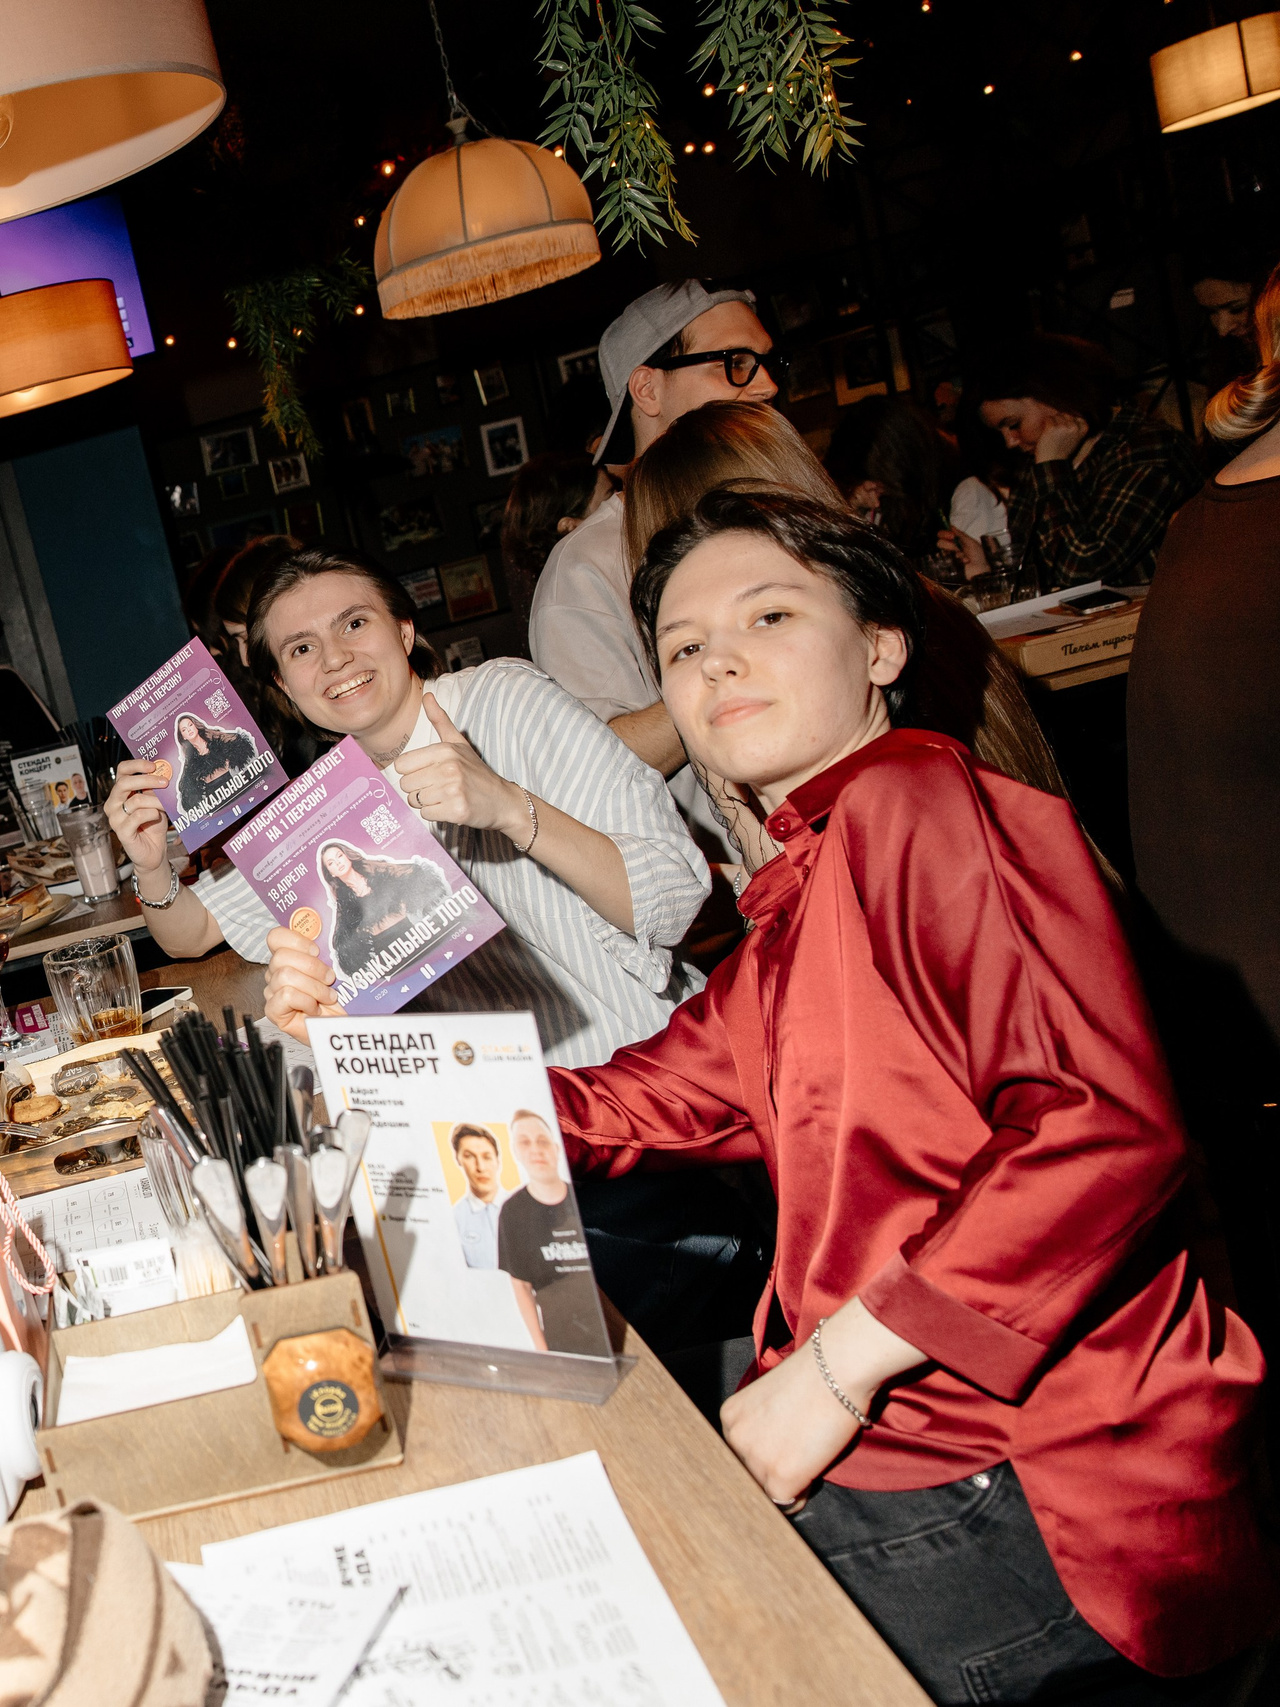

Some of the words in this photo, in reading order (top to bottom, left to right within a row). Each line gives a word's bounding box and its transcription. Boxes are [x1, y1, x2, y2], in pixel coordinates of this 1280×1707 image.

[111, 661, 175, 720] ПРИГЛАСИТЕЛЬНЫЙ
[171, 644, 195, 669] БИЛЕТ
[152, 671, 183, 701] ПЕРСОНУ
[138, 700, 152, 713] НА
[149, 695, 157, 704] 1
[137, 745, 147, 756] 18
[144, 728, 169, 750] АПРЕЛЯ
[18, 756, 51, 770] СТЕНДАП
[19, 763, 52, 776] КОНЦЕРТ
[173, 770, 249, 834] МУЗЫКАЛЬНОЕ
[246, 750, 275, 780] ЛОТО
[229, 771, 313, 854] ПРИГЛАСИТЕЛЬНЫЙ
[312, 746, 346, 780] БИЛЕТ
[265, 825, 284, 843] НА
[279, 818, 290, 830] 1
[285, 783, 328, 826] ПЕРСОНУ
[267, 888, 280, 902] 18
[276, 862, 309, 895] АПРЕЛЯ
[276, 890, 298, 913] 17:00
[337, 914, 441, 1007] МУЗЫКАЛЬНОЕ
[435, 885, 479, 927] ЛОТО
[374, 988, 389, 1001] 02:20
[329, 1033, 436, 1054] СТЕНДАП
[64, 1067, 83, 1077] БАР
[334, 1057, 440, 1077] КОНЦЕРТ
